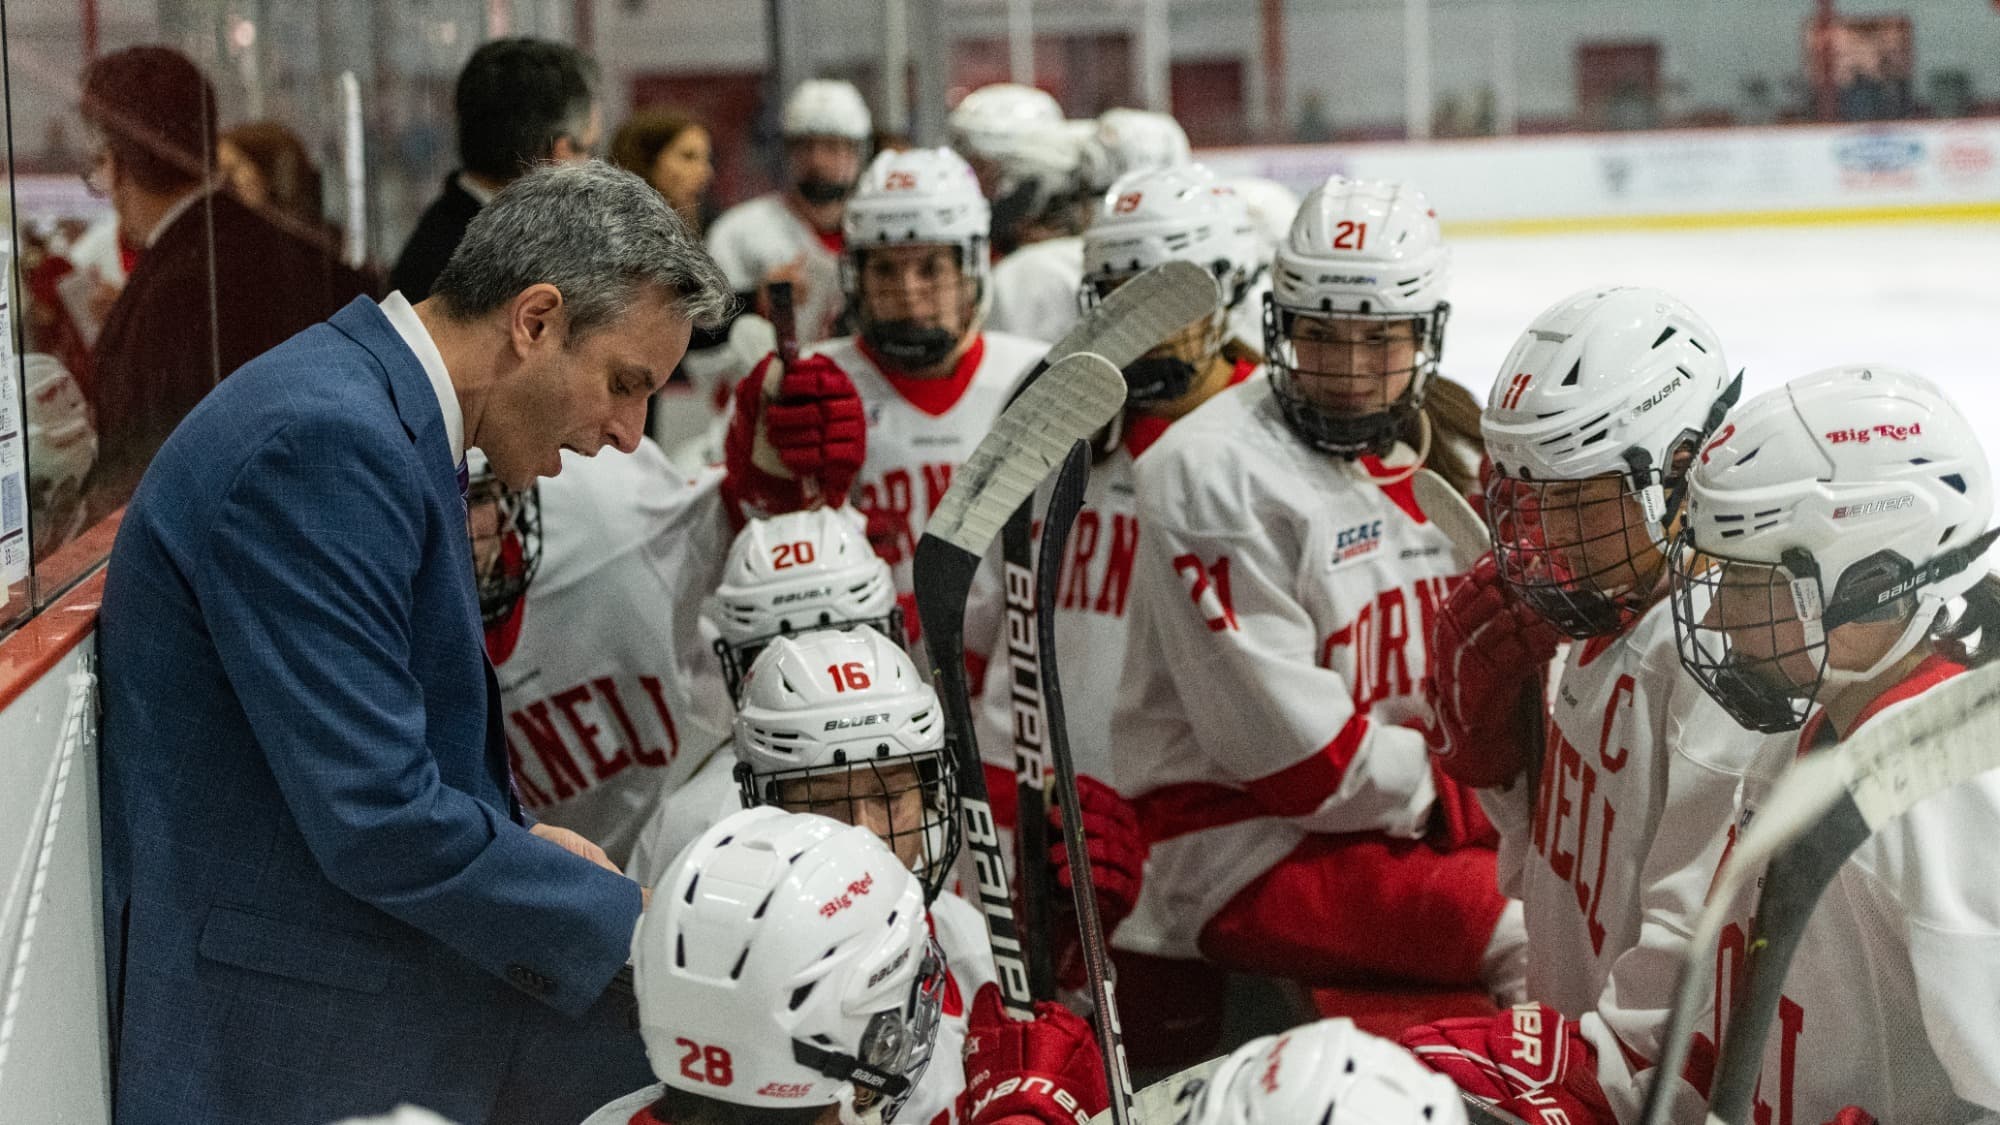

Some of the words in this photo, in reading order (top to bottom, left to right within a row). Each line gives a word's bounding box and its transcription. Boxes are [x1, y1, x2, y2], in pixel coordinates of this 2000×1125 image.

[1333, 221, 1366, 250] 21
[1502, 373, 1533, 410] 11
[1826, 428, 1870, 444] Big
[1873, 422, 1921, 441] Red
[772, 541, 815, 570] 20
[1173, 553, 1239, 632] 21
[1878, 569, 1939, 604] BAUE
[828, 662, 871, 693] 16
[824, 713, 890, 732] BAUER
[1600, 673, 1636, 774] C
[819, 894, 853, 918] Big
[847, 871, 873, 895] Red
[868, 947, 910, 989] BAUER
[675, 1037, 733, 1087] 28
[851, 1068, 887, 1088] BAUER
